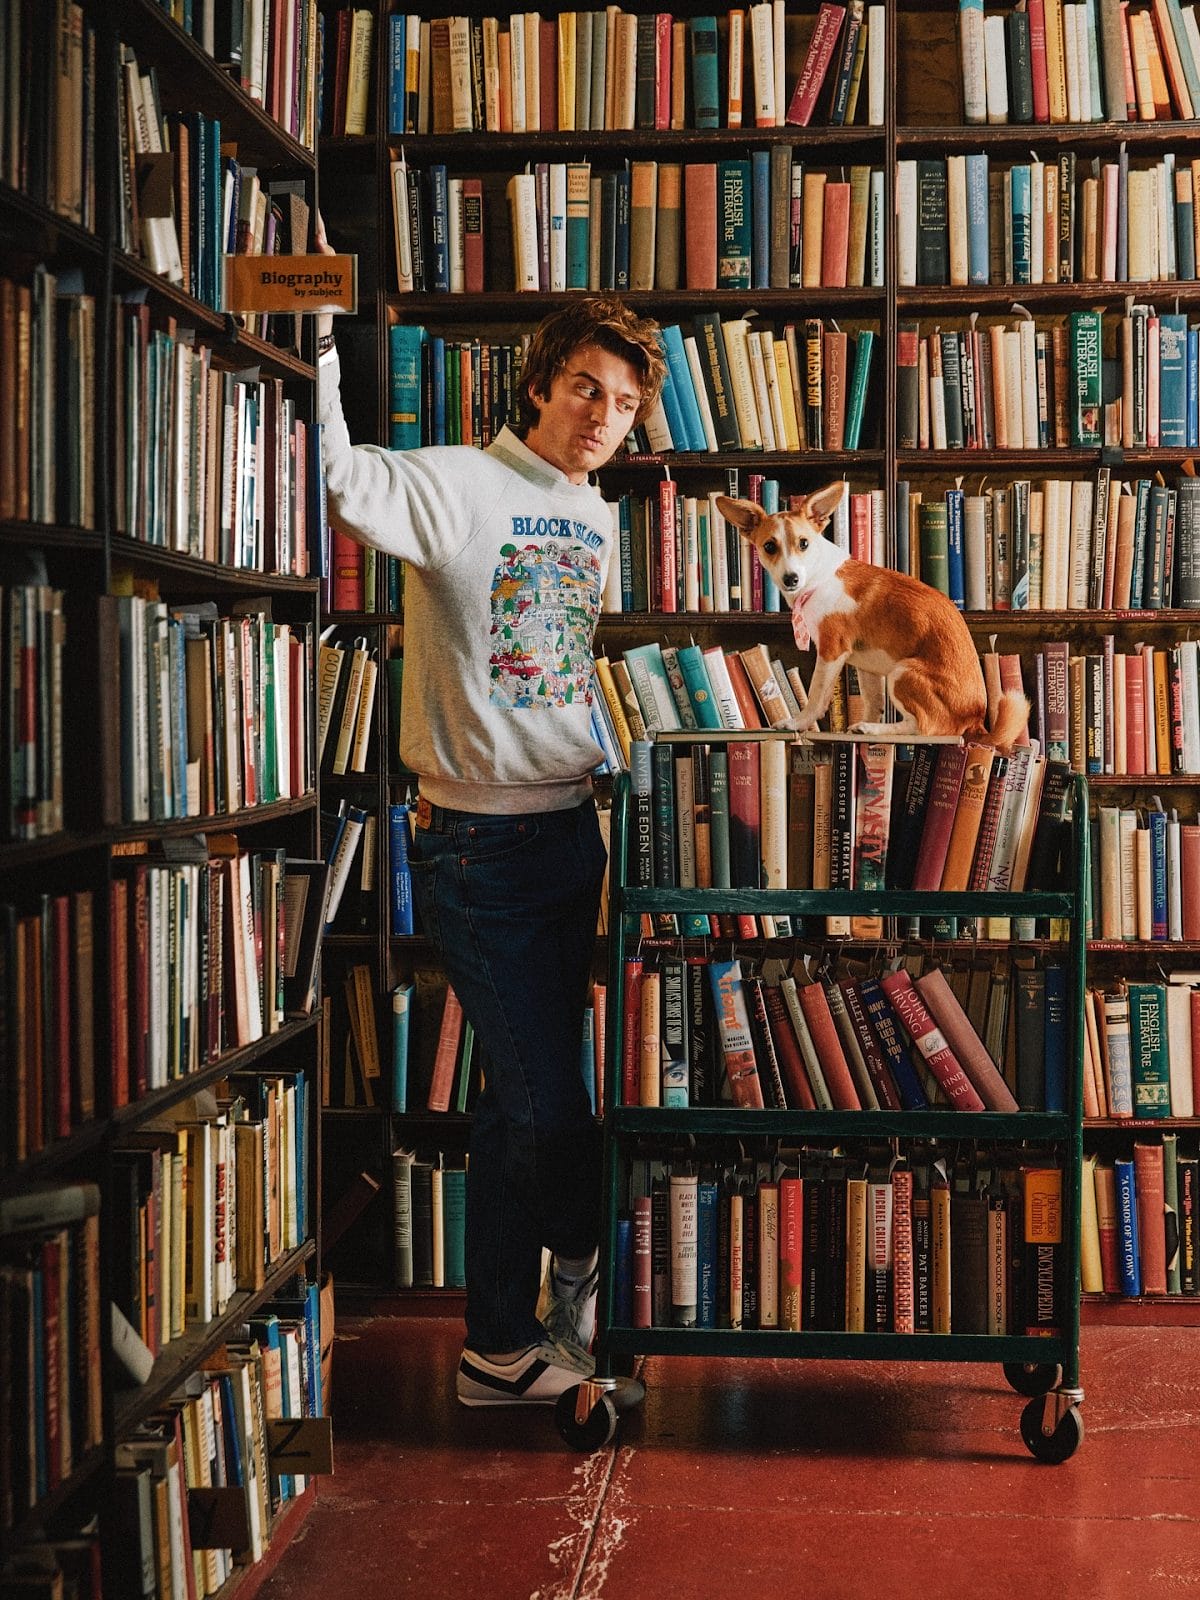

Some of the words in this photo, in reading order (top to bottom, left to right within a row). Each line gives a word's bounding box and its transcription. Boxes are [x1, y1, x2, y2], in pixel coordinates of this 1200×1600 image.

[812, 8, 832, 48] Katherine
[832, 16, 841, 31] The
[805, 47, 820, 69] Anne
[816, 31, 837, 69] Collected
[795, 70, 813, 98] Porter
[723, 178, 734, 242] LITERATURE
[733, 179, 743, 227] ENGLISH
[261, 271, 343, 288] Biography
[295, 288, 306, 298] by
[309, 288, 343, 298] subject
[807, 338, 822, 385] DICKENS
[1076, 330, 1088, 396] LITERATURE
[1088, 330, 1097, 377] ENGLISH
[807, 386, 821, 406] 1970
[829, 374, 839, 409] October
[829, 410, 839, 433] Light
[511, 516, 573, 538] BLOCK
[621, 529, 632, 593] BERENSON
[663, 542, 671, 553] the
[1048, 661, 1057, 714] LITERATURE
[1056, 660, 1065, 714] CHILDREN'S
[923, 761, 932, 776] THE
[1074, 748, 1081, 761] DO
[637, 750, 650, 812] INVISIBLE
[838, 753, 847, 821] DISCLOSURE
[919, 776, 930, 795] BOOK
[1014, 753, 1030, 793] FALLACI
[658, 774, 671, 827] SEVENTH
[908, 796, 919, 817] PAGE
[917, 796, 925, 806] OF
[681, 809, 690, 838] Nadine
[861, 767, 887, 865] DYNASTY
[639, 816, 650, 853] EDEN
[815, 822, 823, 859] HEAVENS
[658, 831, 672, 880] HEAVEN
[682, 840, 691, 880] Gordimer
[831, 829, 839, 883] CRICHTON
[842, 831, 852, 881] MICHAEL
[665, 976, 683, 1001] SMILLA'S
[692, 965, 703, 1026] PENTIMENTO
[718, 976, 743, 1030] triomf
[665, 1001, 683, 1019] SENSE
[845, 987, 866, 1022] BULLET
[858, 1024, 875, 1050] PARK
[868, 999, 887, 1015] HAVE
[890, 988, 923, 1035] IRVING
[902, 987, 929, 1022] JOHN
[665, 1026, 683, 1045] SNOW
[874, 1018, 893, 1033] EVER
[879, 1026, 896, 1039] LIED
[1139, 1003, 1151, 1068] LITERATURE
[1149, 1003, 1160, 1052] ENGLISH
[885, 1035, 896, 1046] TO
[887, 1045, 903, 1056] YOU
[895, 1055, 902, 1064] ?
[928, 1048, 953, 1066] UNTIL
[942, 1069, 965, 1088] FIND
[949, 1085, 970, 1098] YOU
[786, 1185, 797, 1207] JOHN
[875, 1189, 886, 1224] MICHAEL
[895, 1176, 911, 1215] CHILDREN
[1048, 1193, 1060, 1208] The
[1122, 1186, 1133, 1223] COSMOS
[995, 1222, 1002, 1231] OF
[1031, 1192, 1047, 1236] Columbia
[1048, 1208, 1060, 1237] Concise
[215, 1201, 226, 1265] WILSON
[875, 1226, 886, 1265] CRICHTON
[1124, 1225, 1133, 1238] OF
[1124, 1239, 1135, 1253] MY
[702, 1262, 711, 1270] A
[919, 1253, 928, 1272] PAT
[702, 1270, 712, 1291] House
[702, 1291, 712, 1299] of
[875, 1269, 887, 1293] STATE
[1037, 1245, 1055, 1321] ENCYCLOPEDIA
[702, 1300, 713, 1322] Lions
[896, 1293, 912, 1319] STONE
[919, 1276, 928, 1317] BARKER
[995, 1292, 1003, 1324] ERICKSON
[875, 1304, 887, 1323] FEAR
[270, 1419, 311, 1459] Z
